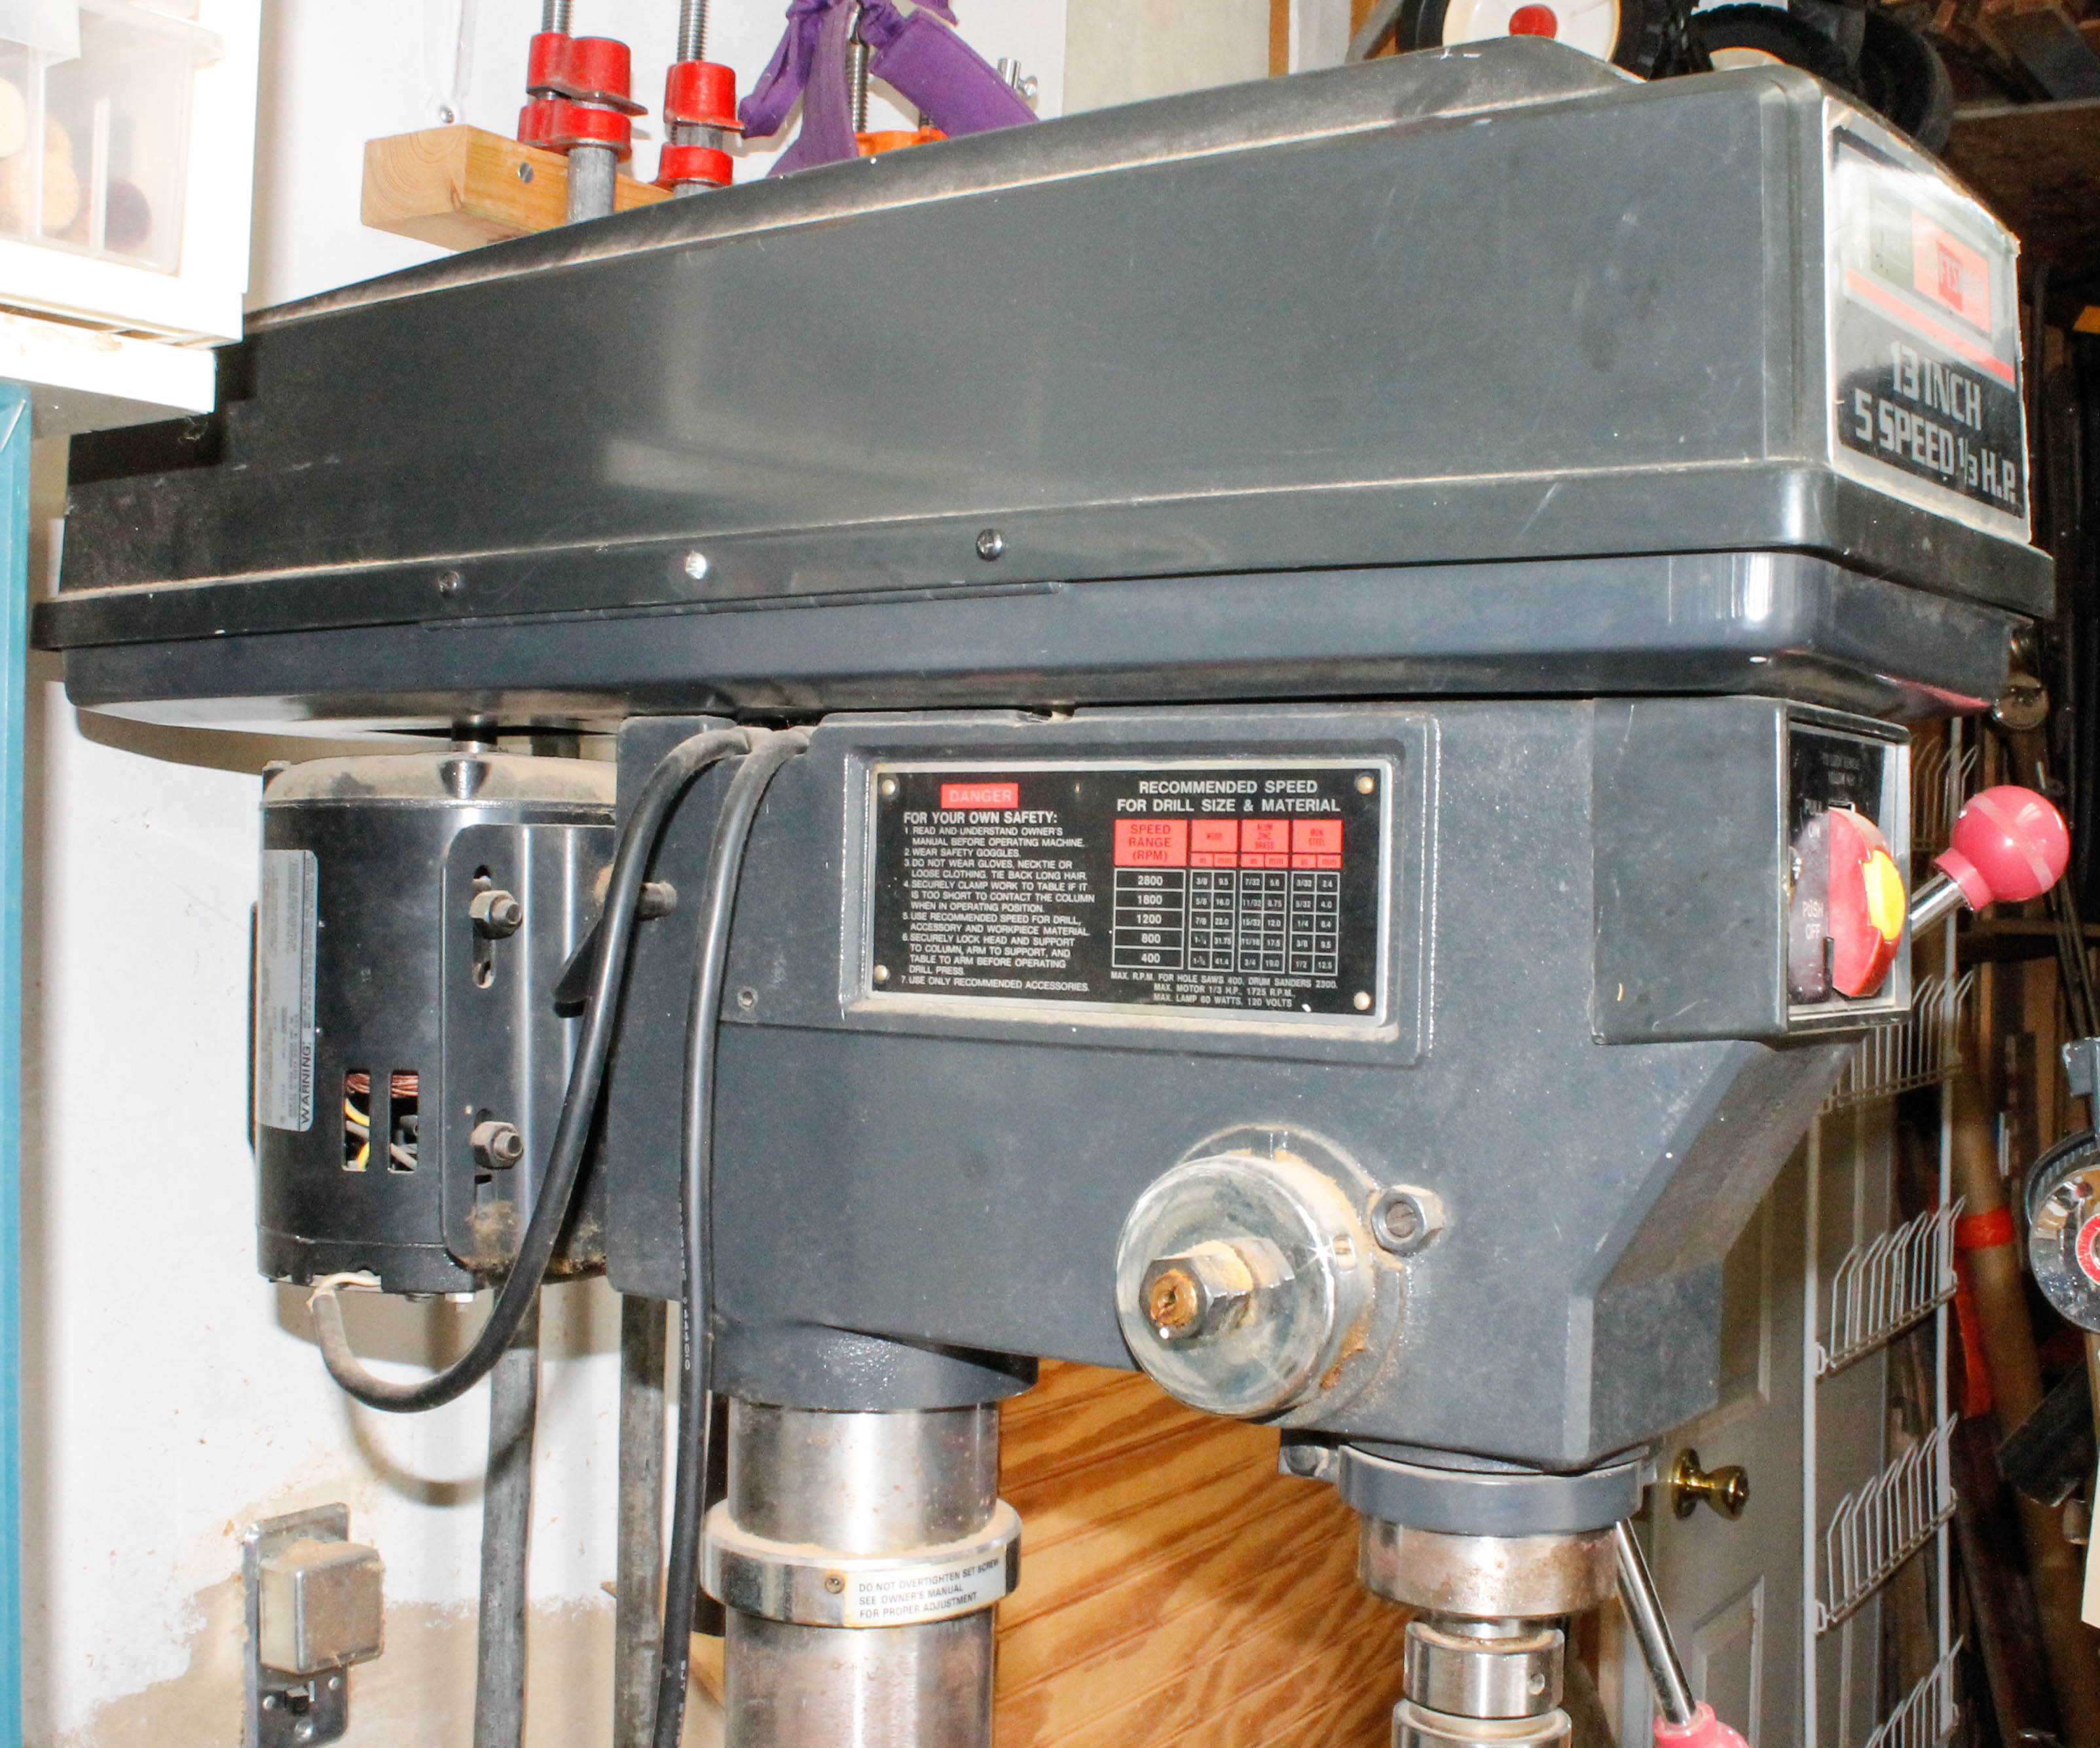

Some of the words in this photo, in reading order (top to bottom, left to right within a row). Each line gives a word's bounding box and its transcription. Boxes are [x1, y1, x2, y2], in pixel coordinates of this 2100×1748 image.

[1890, 342, 1919, 401] 13
[1925, 357, 1982, 430] INCH
[1855, 388, 1873, 442] 5
[1879, 398, 1955, 475] SPEED
[1981, 448, 2016, 505] H.P.
[1139, 780, 1258, 794] RECOMMENDED
[1264, 780, 1318, 794] SPEED
[949, 790, 1012, 803] DANGER
[1117, 799, 1147, 812] FOR
[1152, 799, 1195, 812] DRILL
[1201, 798, 1236, 812] SIZE
[1243, 799, 1254, 812] &
[1261, 798, 1341, 812] MATERIAL
[904, 811, 928, 824] FOR
[932, 811, 965, 824] YOUR
[969, 811, 1000, 824] OWN
[1004, 810, 1058, 824] SAFETY:
[912, 827, 936, 835] READ
[939, 827, 957, 835] AND
[960, 827, 1018, 836] UNDERSTAND
[1021, 827, 1063, 836] OWNER'S
[1130, 824, 1171, 835] SPEED
[912, 837, 948, 846] MANUAL
[951, 837, 986, 847] BEFORE
[989, 837, 1039, 847] OPERATING
[1042, 838, 1085, 848] MACHINE.
[1128, 837, 1172, 848] RANGE
[912, 848, 938, 856] WEAR
[940, 848, 974, 857] SAFETY
[1132, 850, 1168, 862] (RPM)
[912, 859, 925, 867] DO
[927, 859, 946, 867] NOT
[948, 859, 975, 868] WEAR
[1018, 860, 1056, 869] NECKTIE
[1058, 860, 1073, 869] OR
[912, 869, 940, 878] LOOSE
[991, 870, 1004, 879] TIE
[1008, 871, 1033, 880] BACK
[1036, 871, 1061, 880] LONG
[1064, 872, 1088, 881] HAIR.
[1137, 875, 1164, 886] 2800
[912, 880, 955, 889] SECURELY
[958, 881, 988, 889] CLAMP
[991, 882, 1018, 890] WORK
[1022, 883, 1034, 891] TO
[1037, 883, 1065, 891] TABLE
[1068, 883, 1077, 891] IF
[1079, 883, 1088, 891] IT
[911, 890, 919, 899] IS
[922, 890, 940, 900] TOO
[942, 891, 972, 900] SHORT
[975, 892, 987, 900] TO
[989, 892, 1032, 901] CONTACT
[1035, 893, 1053, 901] THE
[1056, 894, 1096, 903] COLUMN
[1137, 895, 1163, 905] 1800
[911, 901, 936, 910] WHEN
[949, 902, 999, 912] OPERATING
[1801, 900, 1824, 918] PUSH
[911, 912, 928, 920] USE
[930, 913, 998, 922] RECOMMENDED
[1000, 914, 1029, 923] SPEED
[1032, 915, 1050, 924] FOR
[1053, 916, 1082, 926] DRILL,
[1136, 914, 1162, 924] 1200
[910, 922, 962, 932] ACCESSORY
[965, 924, 984, 933] AND
[987, 924, 1040, 934] WORKPIECE
[1042, 926, 1091, 936] MATERIAL.
[1805, 923, 1821, 939] OFF
[910, 933, 954, 943] SECURELY
[957, 935, 980, 944] LOCK
[984, 936, 1008, 945] HEAD
[1010, 937, 1030, 945] AND
[1033, 938, 1075, 947] SUPPORT
[1141, 934, 1161, 944] 800
[910, 943, 922, 952] TO
[925, 944, 964, 956] COLUMN,
[967, 946, 987, 955] ARM
[989, 947, 1002, 955] TO
[1004, 947, 1048, 958] SUPPORT,
[1051, 949, 1071, 958] AND
[910, 955, 936, 964] TABLE
[939, 955, 951, 964] TO
[953, 956, 974, 965] ARM
[977, 956, 1012, 967] BEFORE
[1015, 958, 1066, 968] OPERATING
[1141, 953, 1161, 963] 400
[909, 965, 933, 974] DRILL
[909, 975, 926, 985] USE
[928, 976, 951, 986] ONLY
[953, 977, 1022, 989] RECOMMENDED
[1025, 981, 1090, 992] ACCESSORIES.
[1158, 973, 1175, 982] FOR
[1177, 974, 1198, 983] HOLE
[1201, 975, 1225, 984] SAWS
[1248, 977, 1271, 986] DRUM
[1274, 978, 1312, 989] SANDERS
[1176, 984, 1206, 993] MOTOR
[1209, 986, 1223, 994] 1/3
[1247, 987, 1266, 996] 1725
[1176, 994, 1198, 1004] LAMP
[1200, 995, 1211, 1004] 60
[1247, 997, 1262, 1006] 120
[1265, 998, 1293, 1008] VOLTS
[301, 1042, 312, 1124] WARNING:
[858, 1582, 874, 1593] DO
[876, 1581, 896, 1592] NOT
[900, 1571, 961, 1590] OVERTIGHTEN
[963, 1567, 976, 1578] SET
[858, 1595, 877, 1605] SEE
[881, 1590, 925, 1604] OWNER'S
[927, 1584, 963, 1598] MANUAL
[860, 1609, 879, 1619] FOR
[883, 1604, 920, 1617] PROPER
[923, 1592, 978, 1611] ADJUSTMENT
